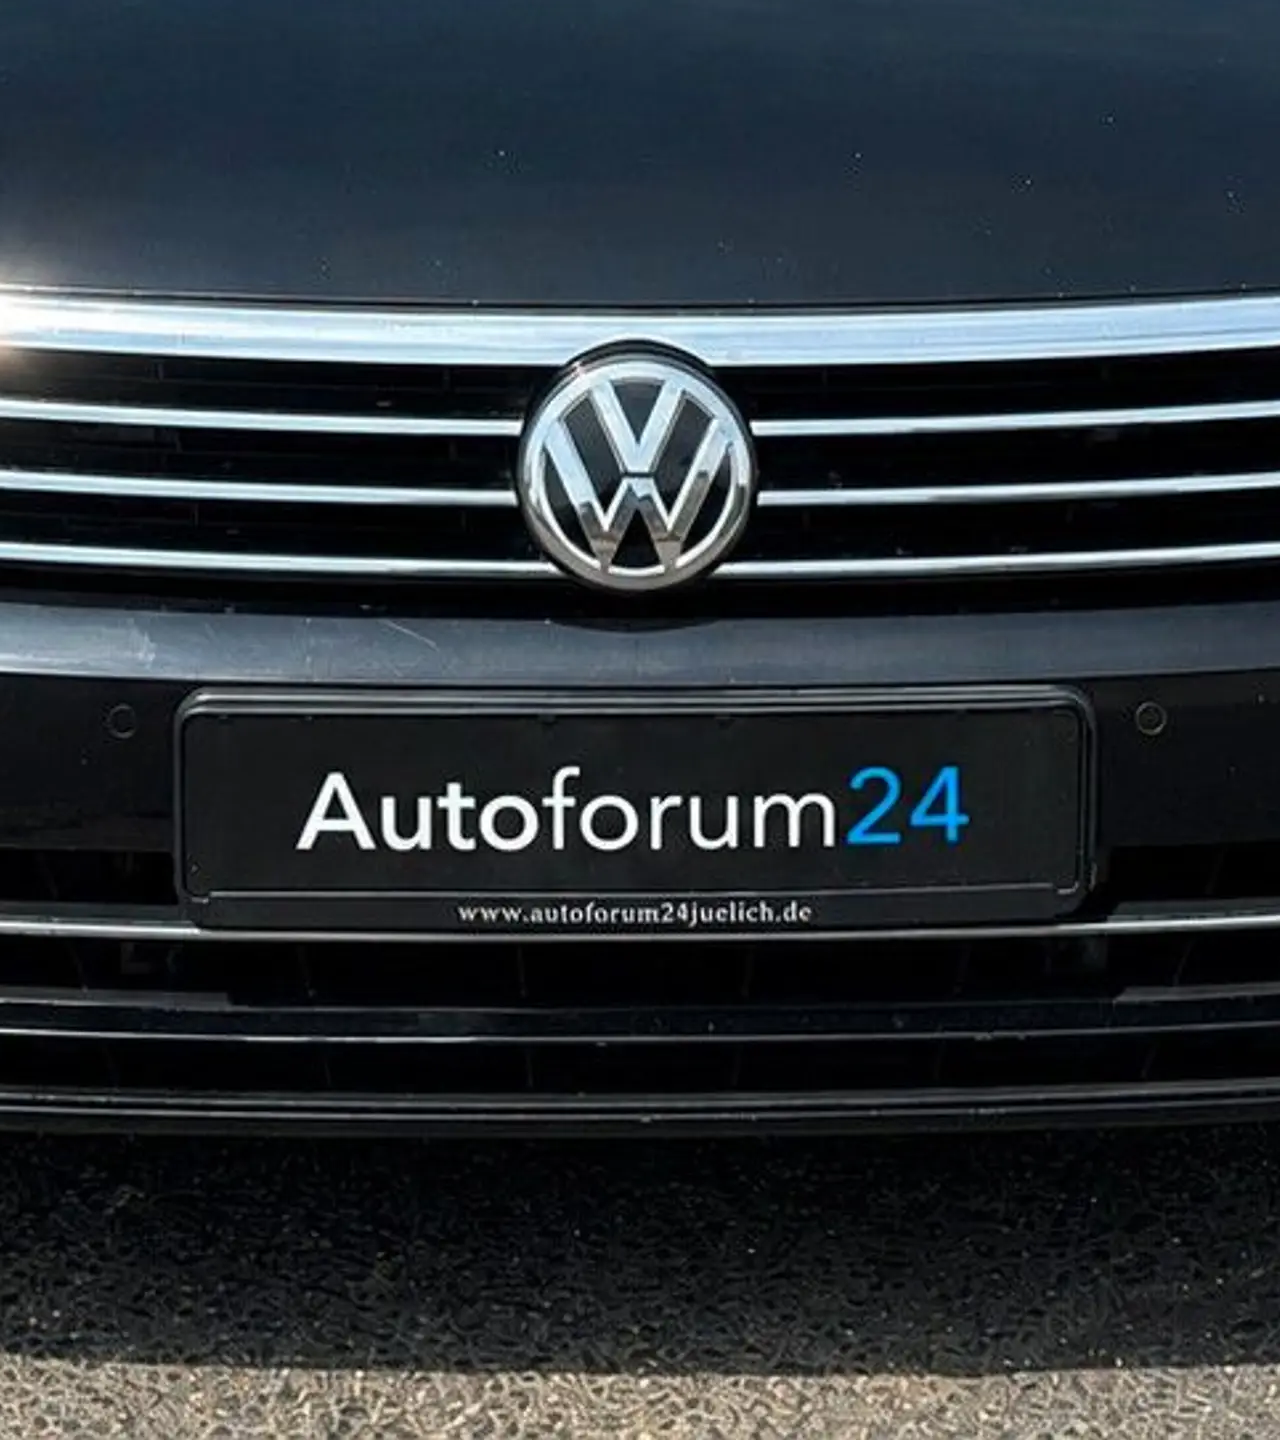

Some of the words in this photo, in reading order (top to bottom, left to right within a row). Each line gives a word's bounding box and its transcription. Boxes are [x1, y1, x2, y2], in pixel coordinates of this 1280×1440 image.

[532, 361, 743, 578] VW
[295, 765, 970, 852] Autoforum24
[457, 900, 813, 928] www.autoforum24juelich.de
